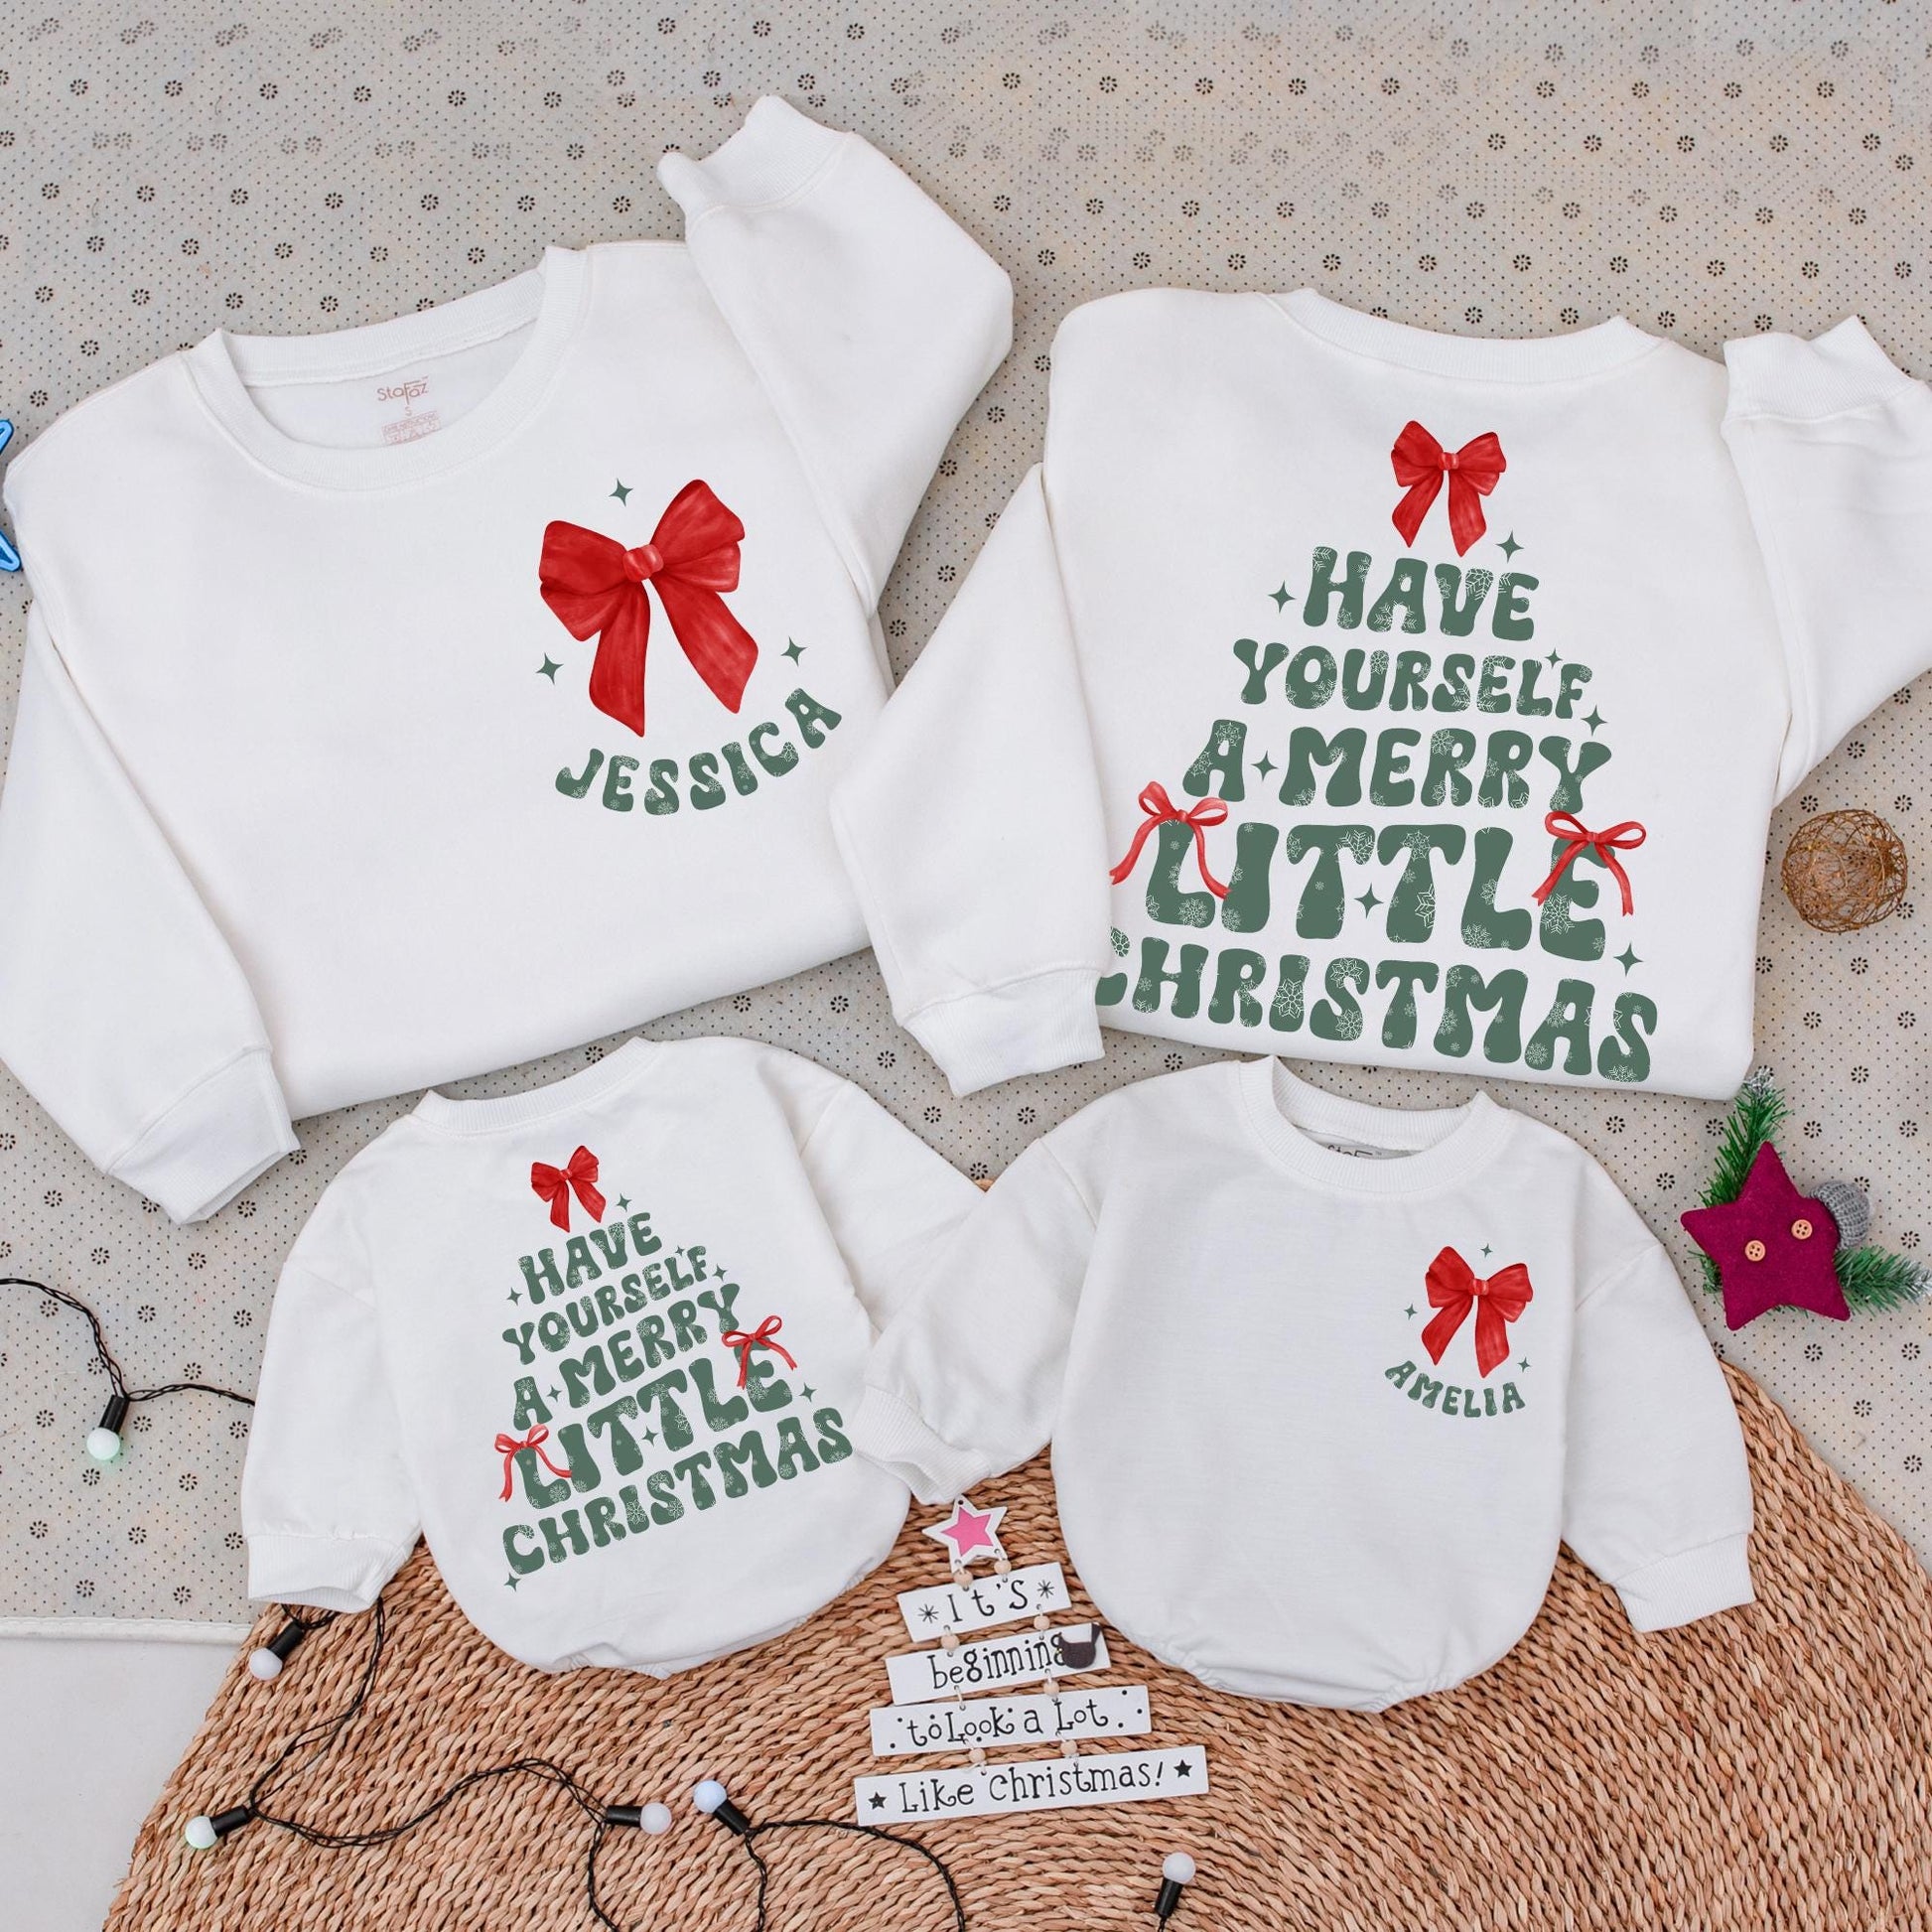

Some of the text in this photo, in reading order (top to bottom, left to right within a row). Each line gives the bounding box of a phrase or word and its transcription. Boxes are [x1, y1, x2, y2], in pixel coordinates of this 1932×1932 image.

[1304, 546, 1539, 641] HAVE
[1233, 638, 1592, 719] YOURSELF
[555, 688, 842, 815] JESSICA
[1182, 719, 1612, 814] A MERRY
[1146, 820, 1616, 961] LITTLE
[502, 1246, 707, 1365] YOURSELF
[518, 1212, 661, 1305] HAVE
[513, 1283, 741, 1431] A MERRY
[1384, 1360, 1526, 1418] AMELIA
[515, 1336, 793, 1509] LITTLE
[503, 1408, 853, 1575] CHRISTMAS
[1024, 1708, 1042, 1734] a
[1053, 1699, 1109, 1731] Lot
[899, 1760, 1164, 1814] Like Christmas!
